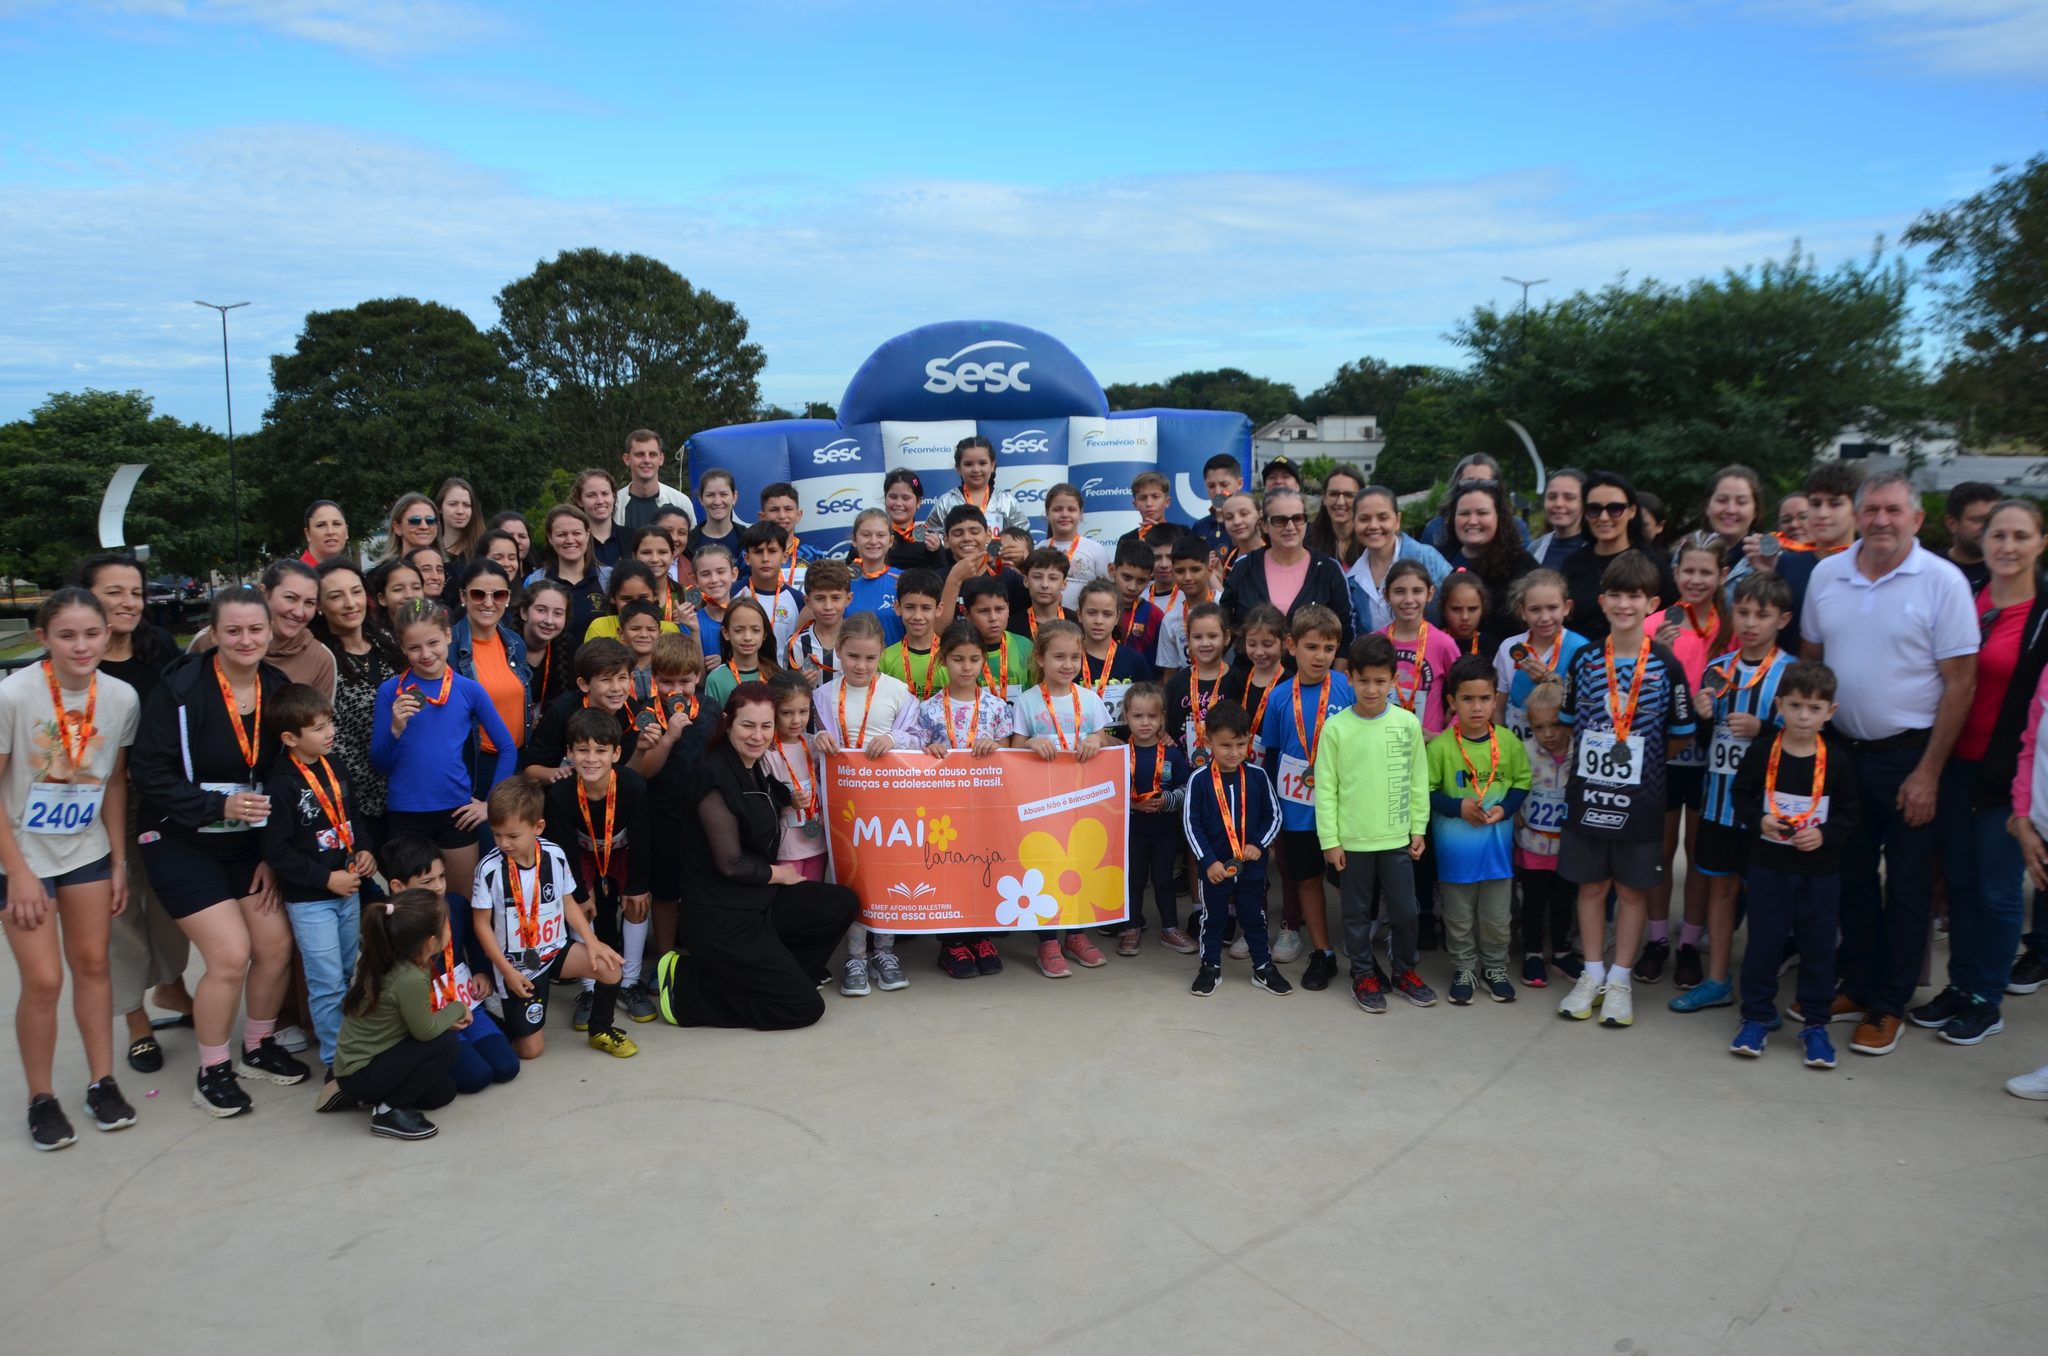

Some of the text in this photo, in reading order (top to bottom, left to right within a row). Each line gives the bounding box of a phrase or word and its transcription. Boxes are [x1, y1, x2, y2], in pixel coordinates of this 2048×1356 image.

[903, 445, 952, 454] Fecomércio
[1086, 438, 1135, 447] Fecomércio
[837, 765, 1003, 777] Mês de combate ao abuso contra
[1586, 749, 1632, 779] 985
[837, 777, 1003, 790] crianças e adolescentes no Brasil.
[1023, 806, 1046, 816] Abuso
[1046, 800, 1061, 810] Não
[1068, 786, 1111, 804] Brincadeira!
[1583, 789, 1631, 808] KTO
[27, 801, 96, 829] 2404
[924, 840, 1006, 888] laranja
[862, 908, 964, 922] abraça essa causa.
[870, 903, 888, 911] EMEF
[918, 903, 952, 911] BALESTRIN
[514, 913, 562, 949] 167
